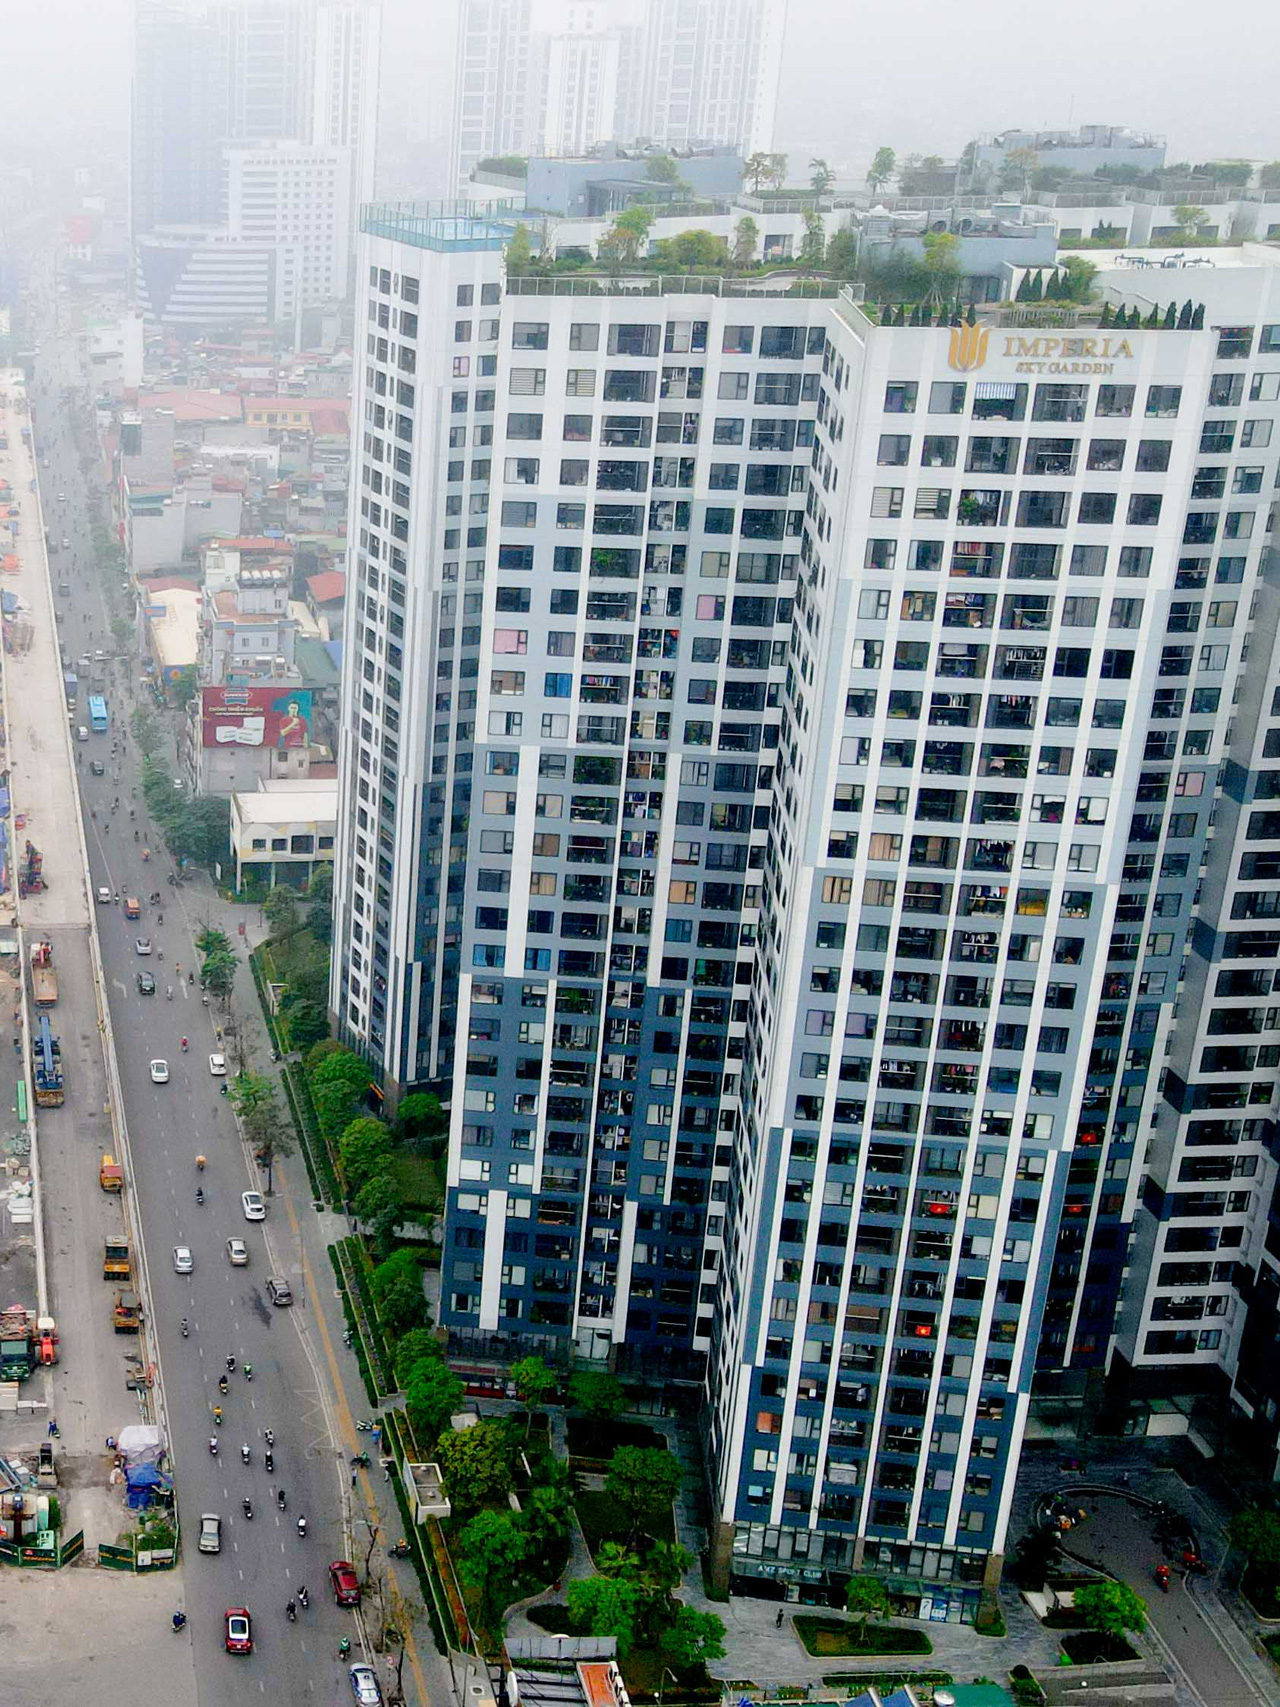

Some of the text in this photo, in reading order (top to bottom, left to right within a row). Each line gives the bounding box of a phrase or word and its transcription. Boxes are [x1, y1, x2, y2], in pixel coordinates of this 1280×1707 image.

[1002, 336, 1134, 358] IMPERIA
[1015, 361, 1115, 375] SKY GARDEN
